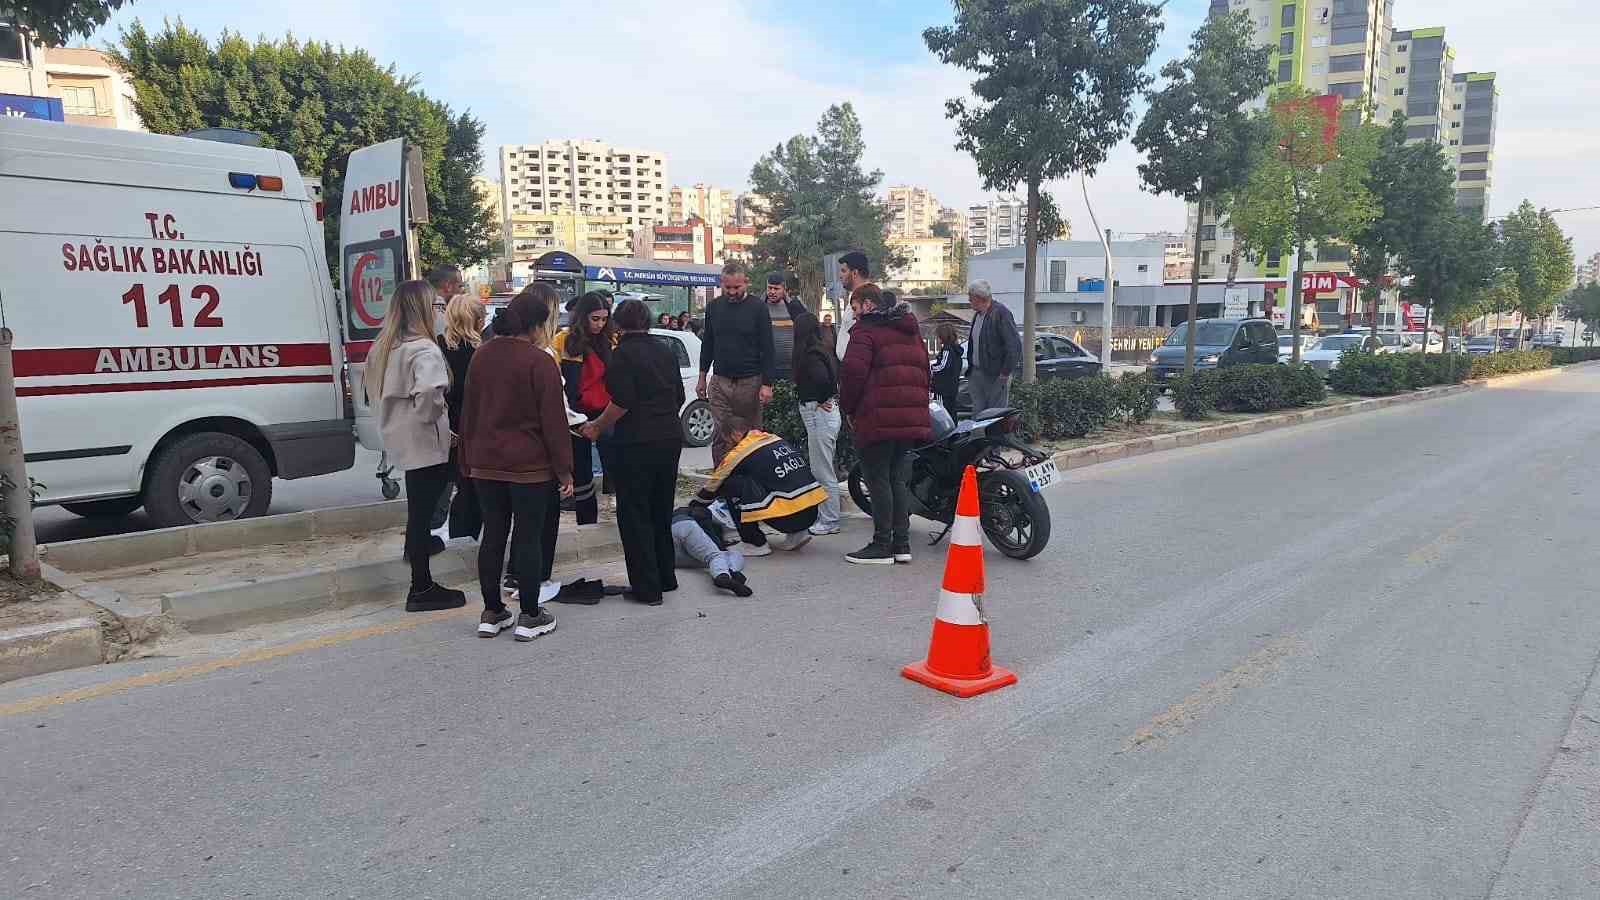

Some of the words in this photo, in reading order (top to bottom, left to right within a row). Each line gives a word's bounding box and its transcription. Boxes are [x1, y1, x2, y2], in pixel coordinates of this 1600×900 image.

[350, 180, 400, 215] AMBU
[144, 212, 185, 240] T.C.
[62, 237, 147, 273] SAĞLIK
[152, 243, 263, 277] BAKANLIĞI
[360, 276, 385, 303] 112
[121, 283, 224, 328] 112
[94, 345, 280, 373] AMBULANS
